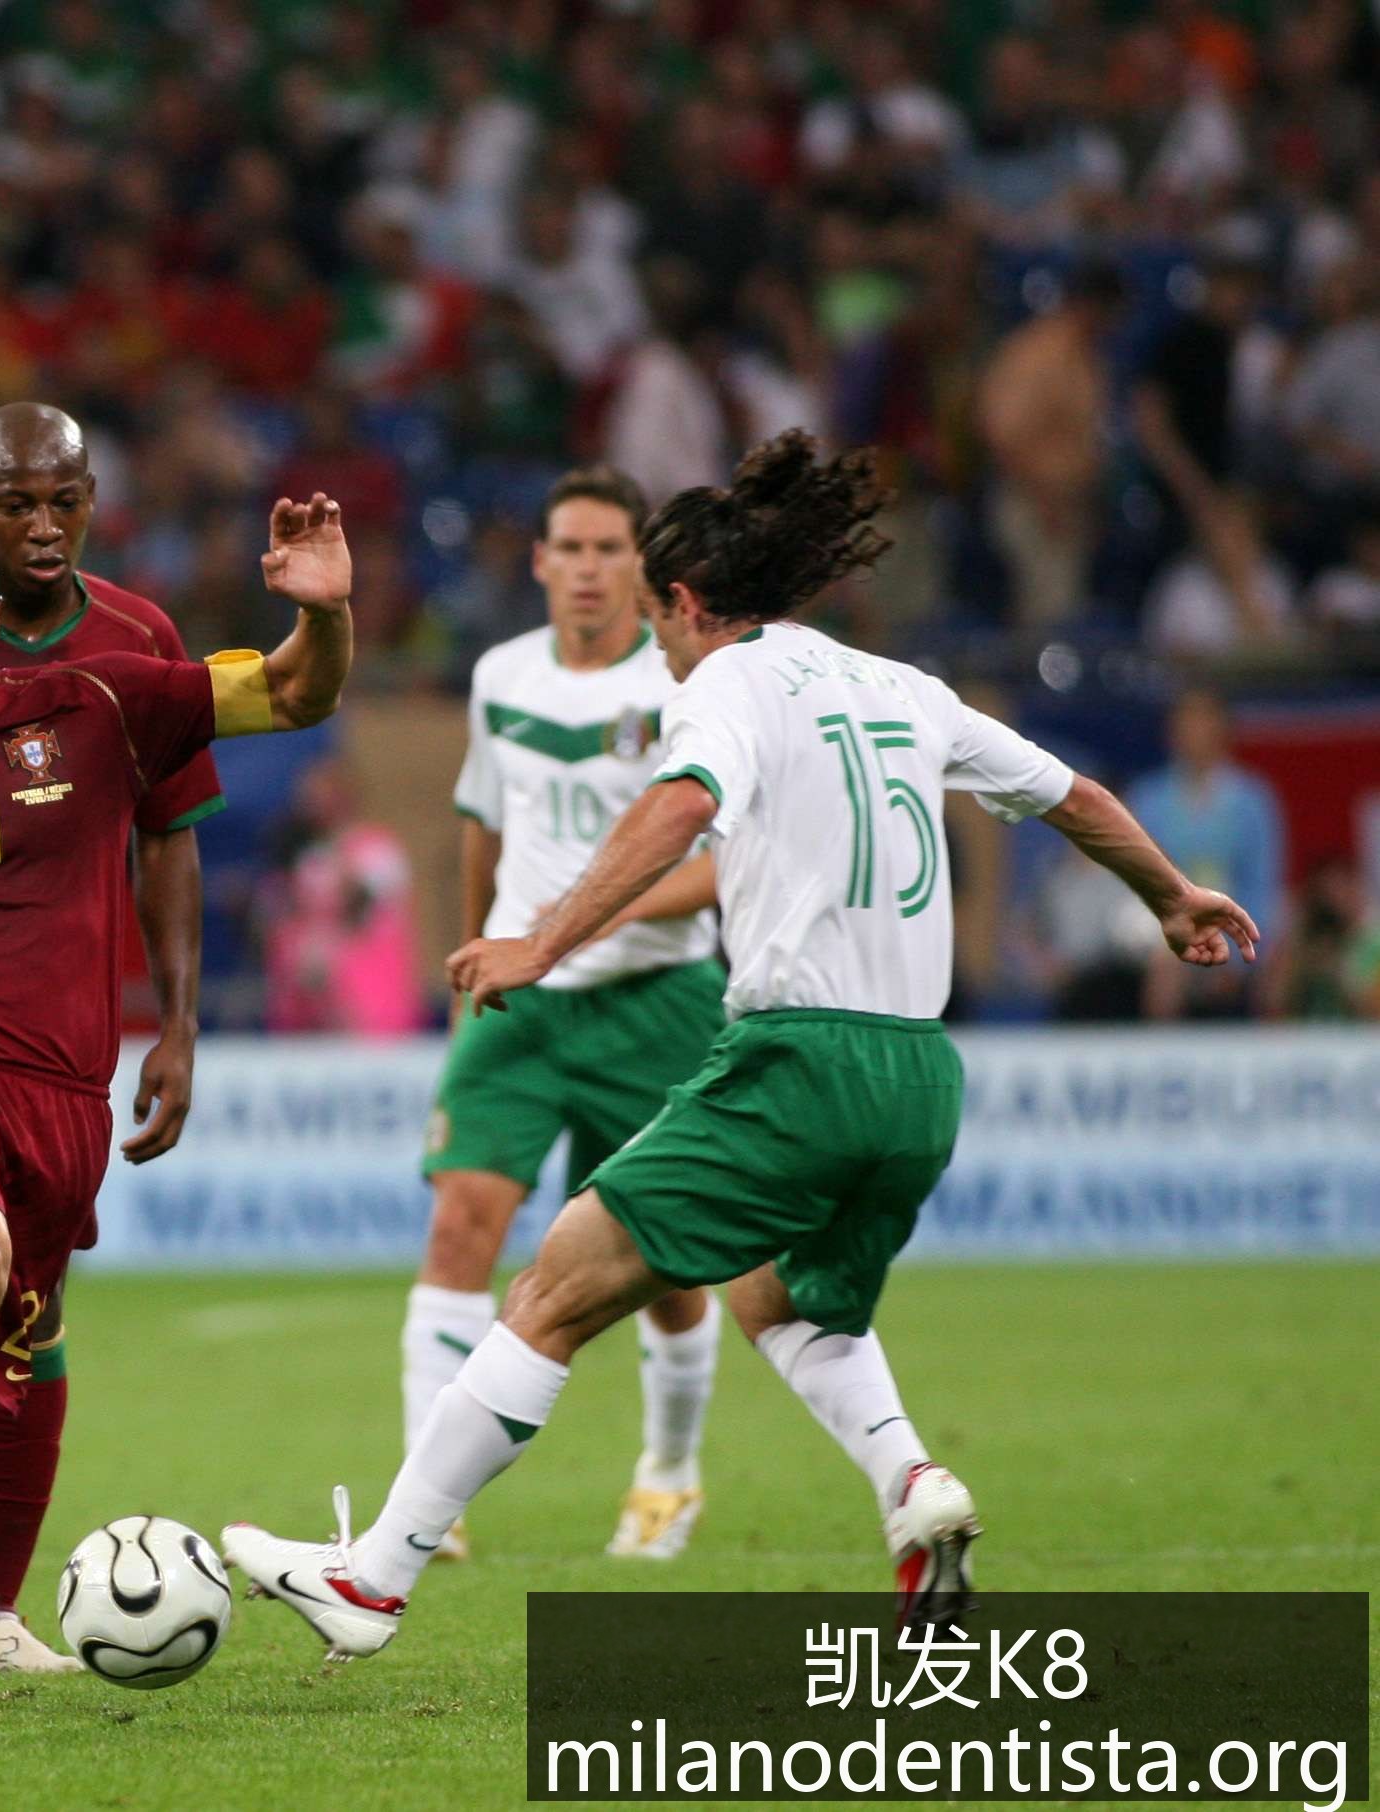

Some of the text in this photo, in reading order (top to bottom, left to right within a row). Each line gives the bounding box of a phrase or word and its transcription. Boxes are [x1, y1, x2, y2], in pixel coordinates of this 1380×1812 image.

[546, 777, 605, 843] 10
[815, 712, 938, 919] 15
[0, 1288, 48, 1361] 2
